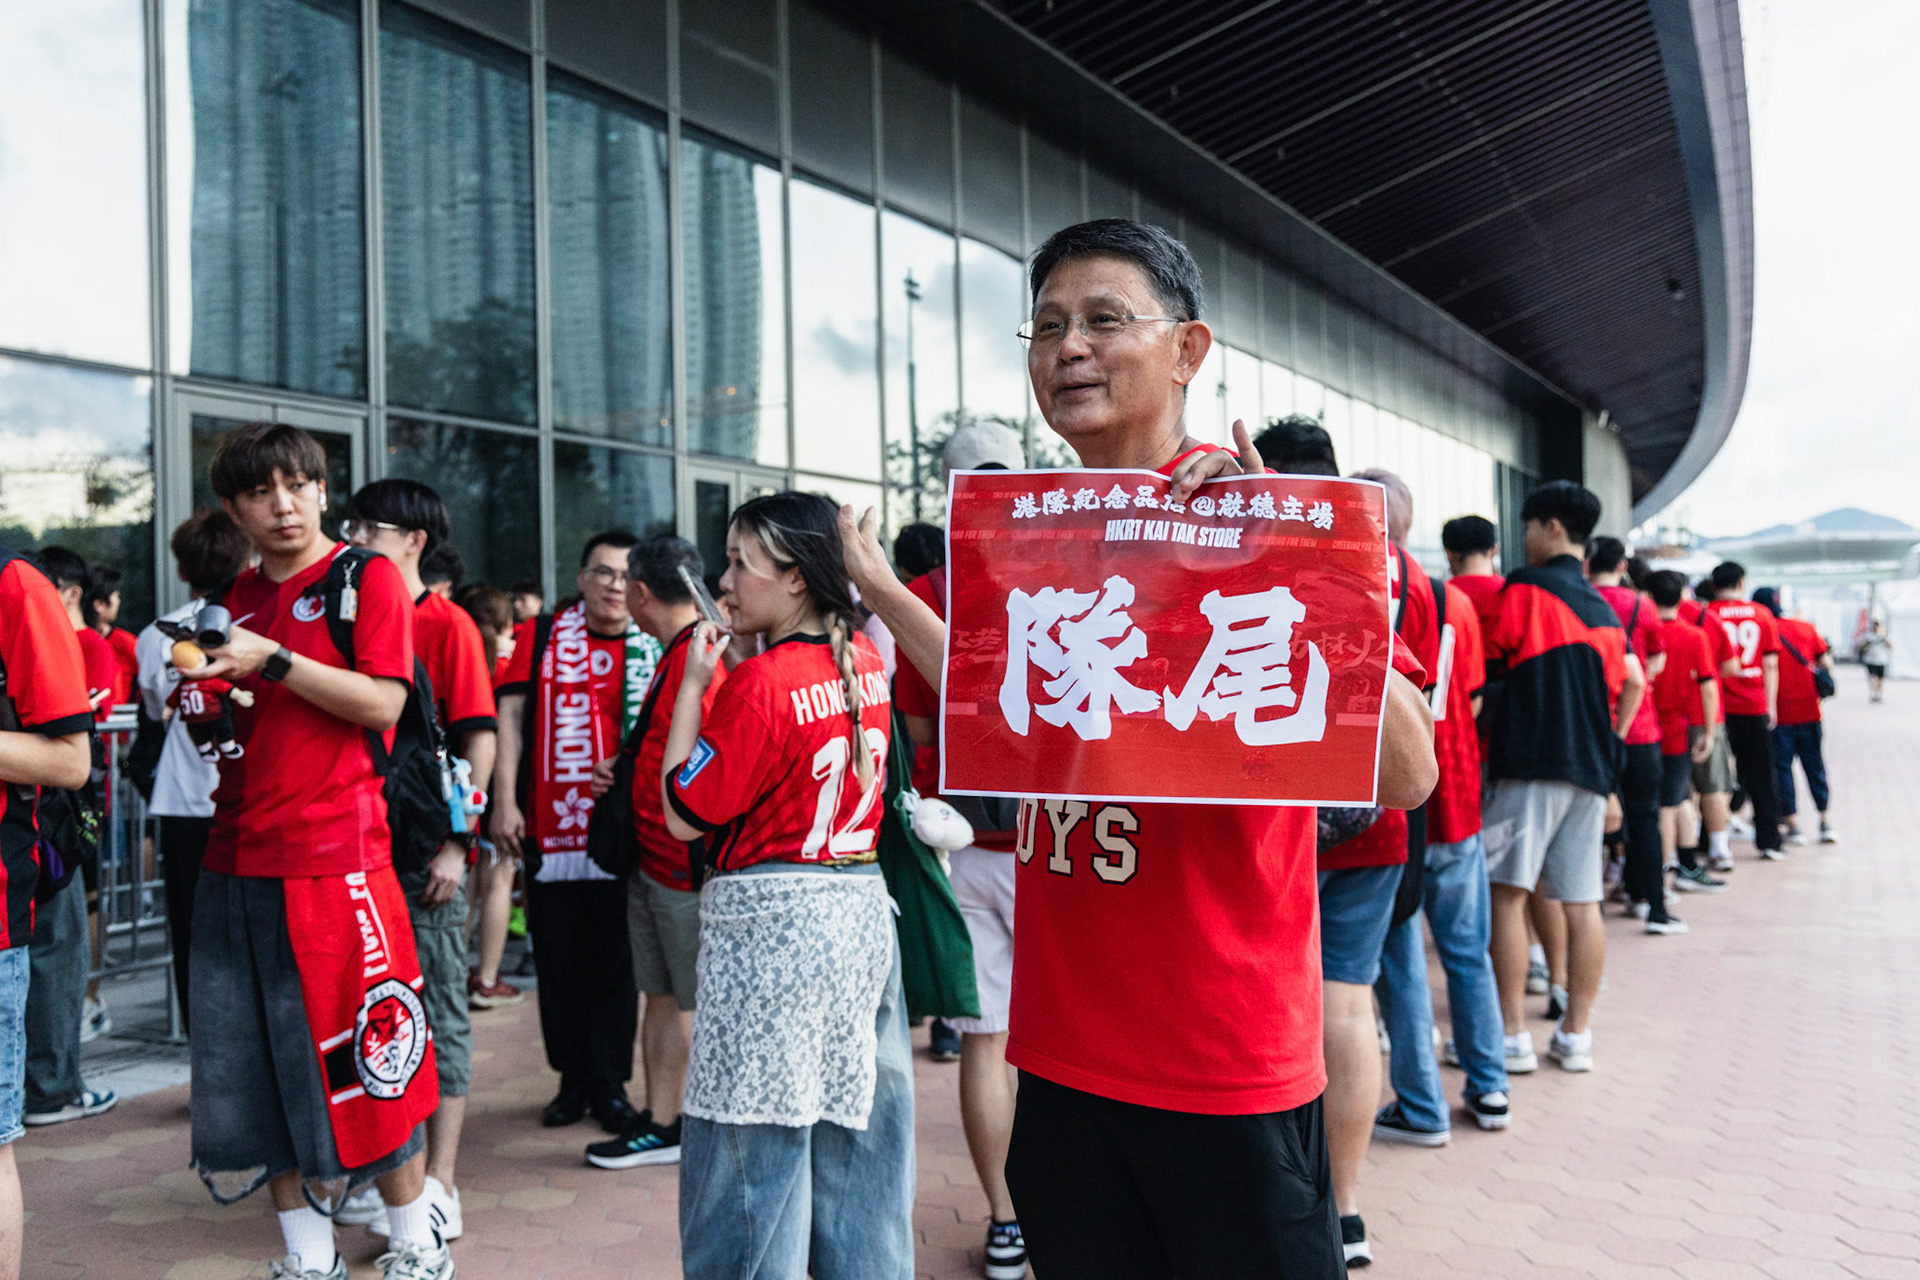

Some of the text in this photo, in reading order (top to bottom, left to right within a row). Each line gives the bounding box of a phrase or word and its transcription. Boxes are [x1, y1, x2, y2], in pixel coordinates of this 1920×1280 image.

[1104, 519, 1243, 549] HKRT KAI TAK STORE
[856, 670, 891, 708] KON
[1000, 575, 1330, 746] 隊尾
[180, 689, 204, 715] 50
[554, 693, 593, 783] HONG
[801, 728, 888, 859] 12
